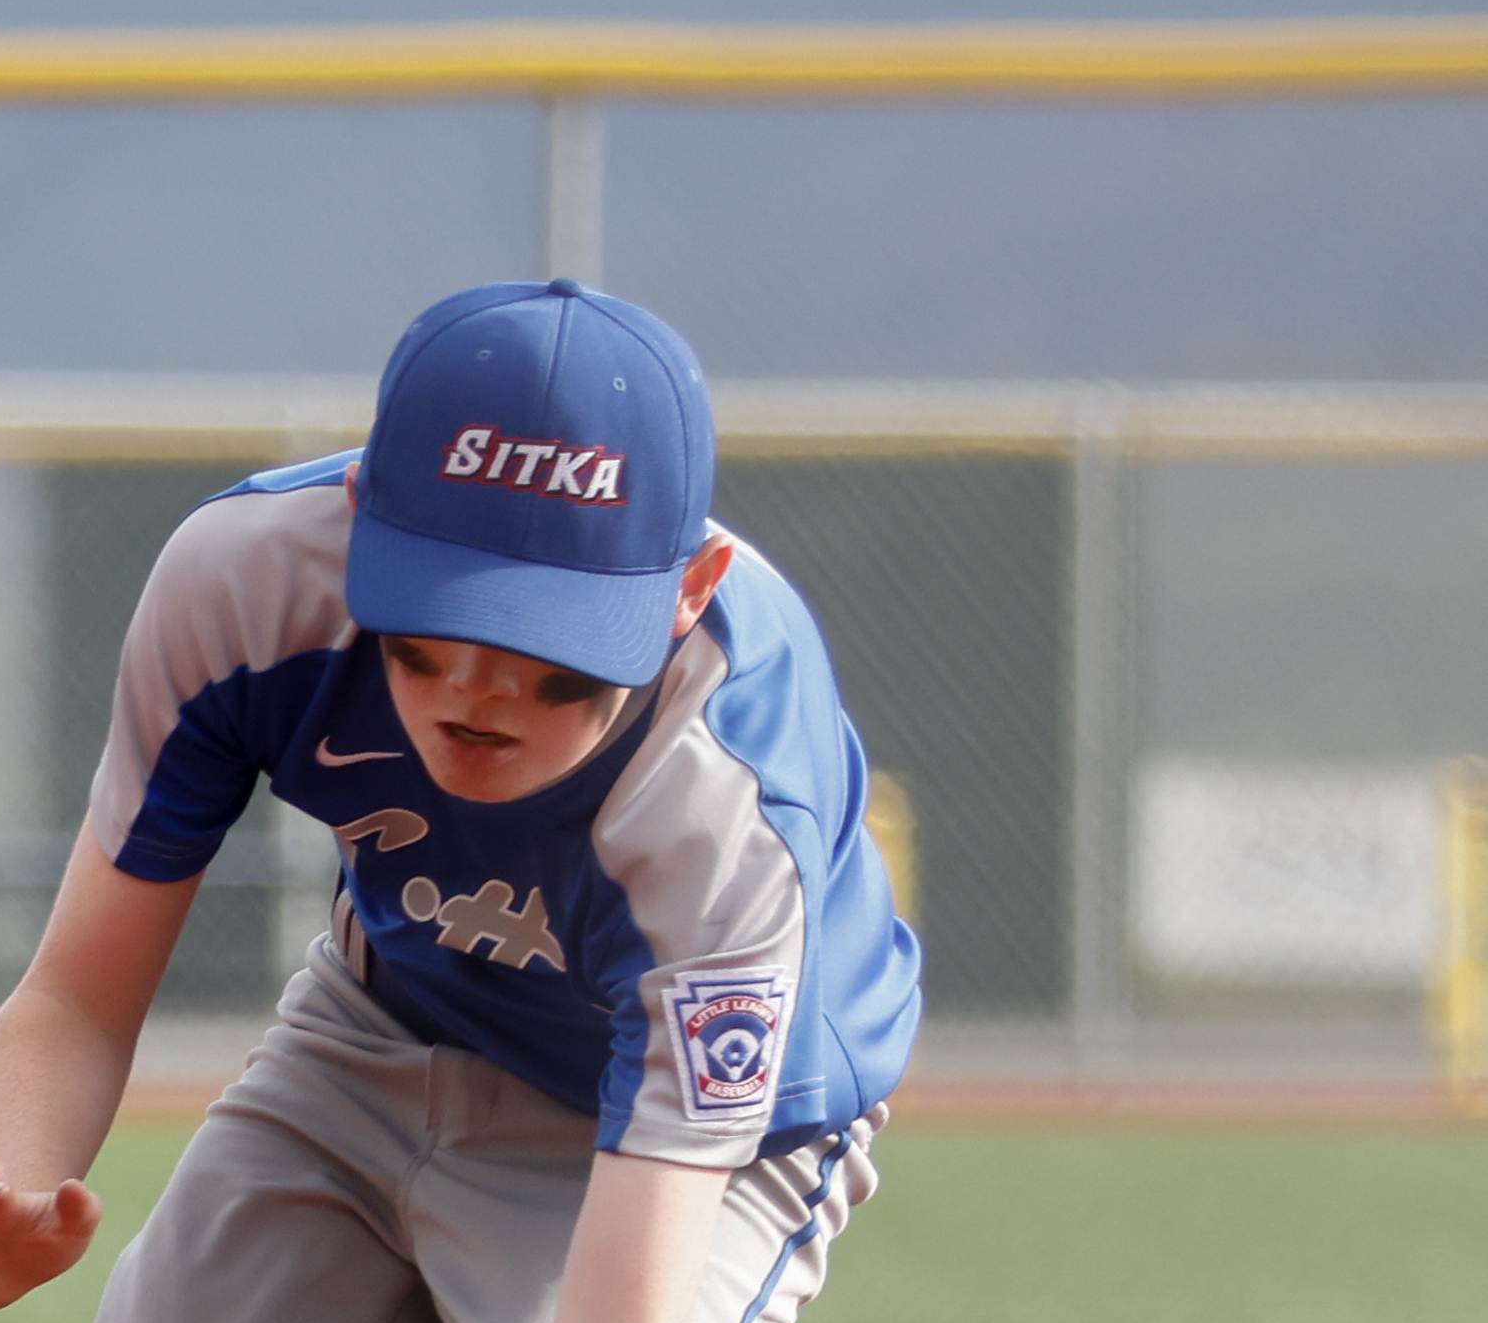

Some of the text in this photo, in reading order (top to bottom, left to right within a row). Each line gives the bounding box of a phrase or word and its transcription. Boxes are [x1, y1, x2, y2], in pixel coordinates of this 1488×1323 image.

[443, 427, 624, 502] SITKA
[691, 999, 731, 1028] LITTLE
[704, 1078, 763, 1098] BASEBALL
